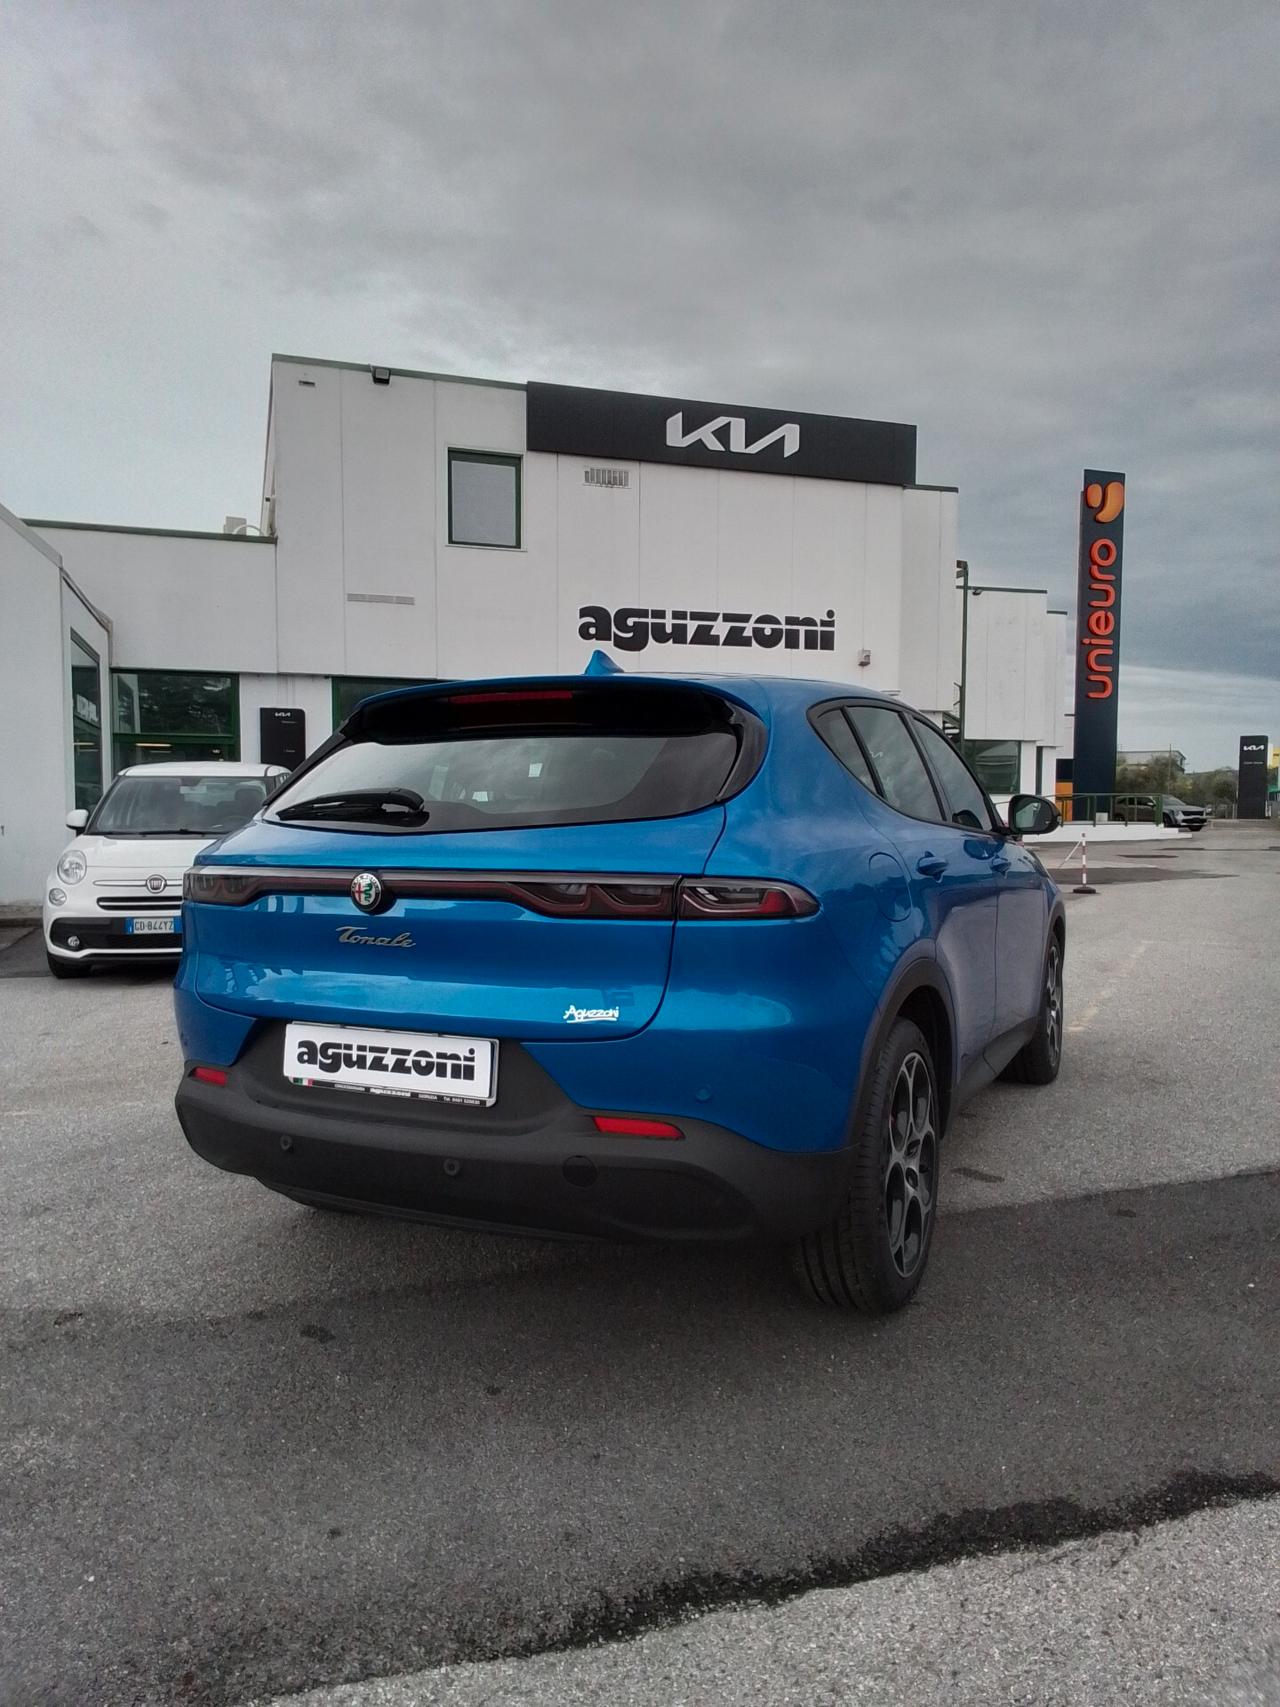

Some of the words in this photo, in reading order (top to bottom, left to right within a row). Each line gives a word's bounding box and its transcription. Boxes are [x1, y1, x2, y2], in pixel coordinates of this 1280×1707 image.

[666, 411, 801, 458] KIA
[578, 605, 836, 651] aguzzoni
[1082, 538, 1117, 700] unieuro
[336, 926, 416, 948] Tonale
[563, 1004, 620, 1022] Aguzzoni
[297, 1039, 475, 1081] aguzzoni
